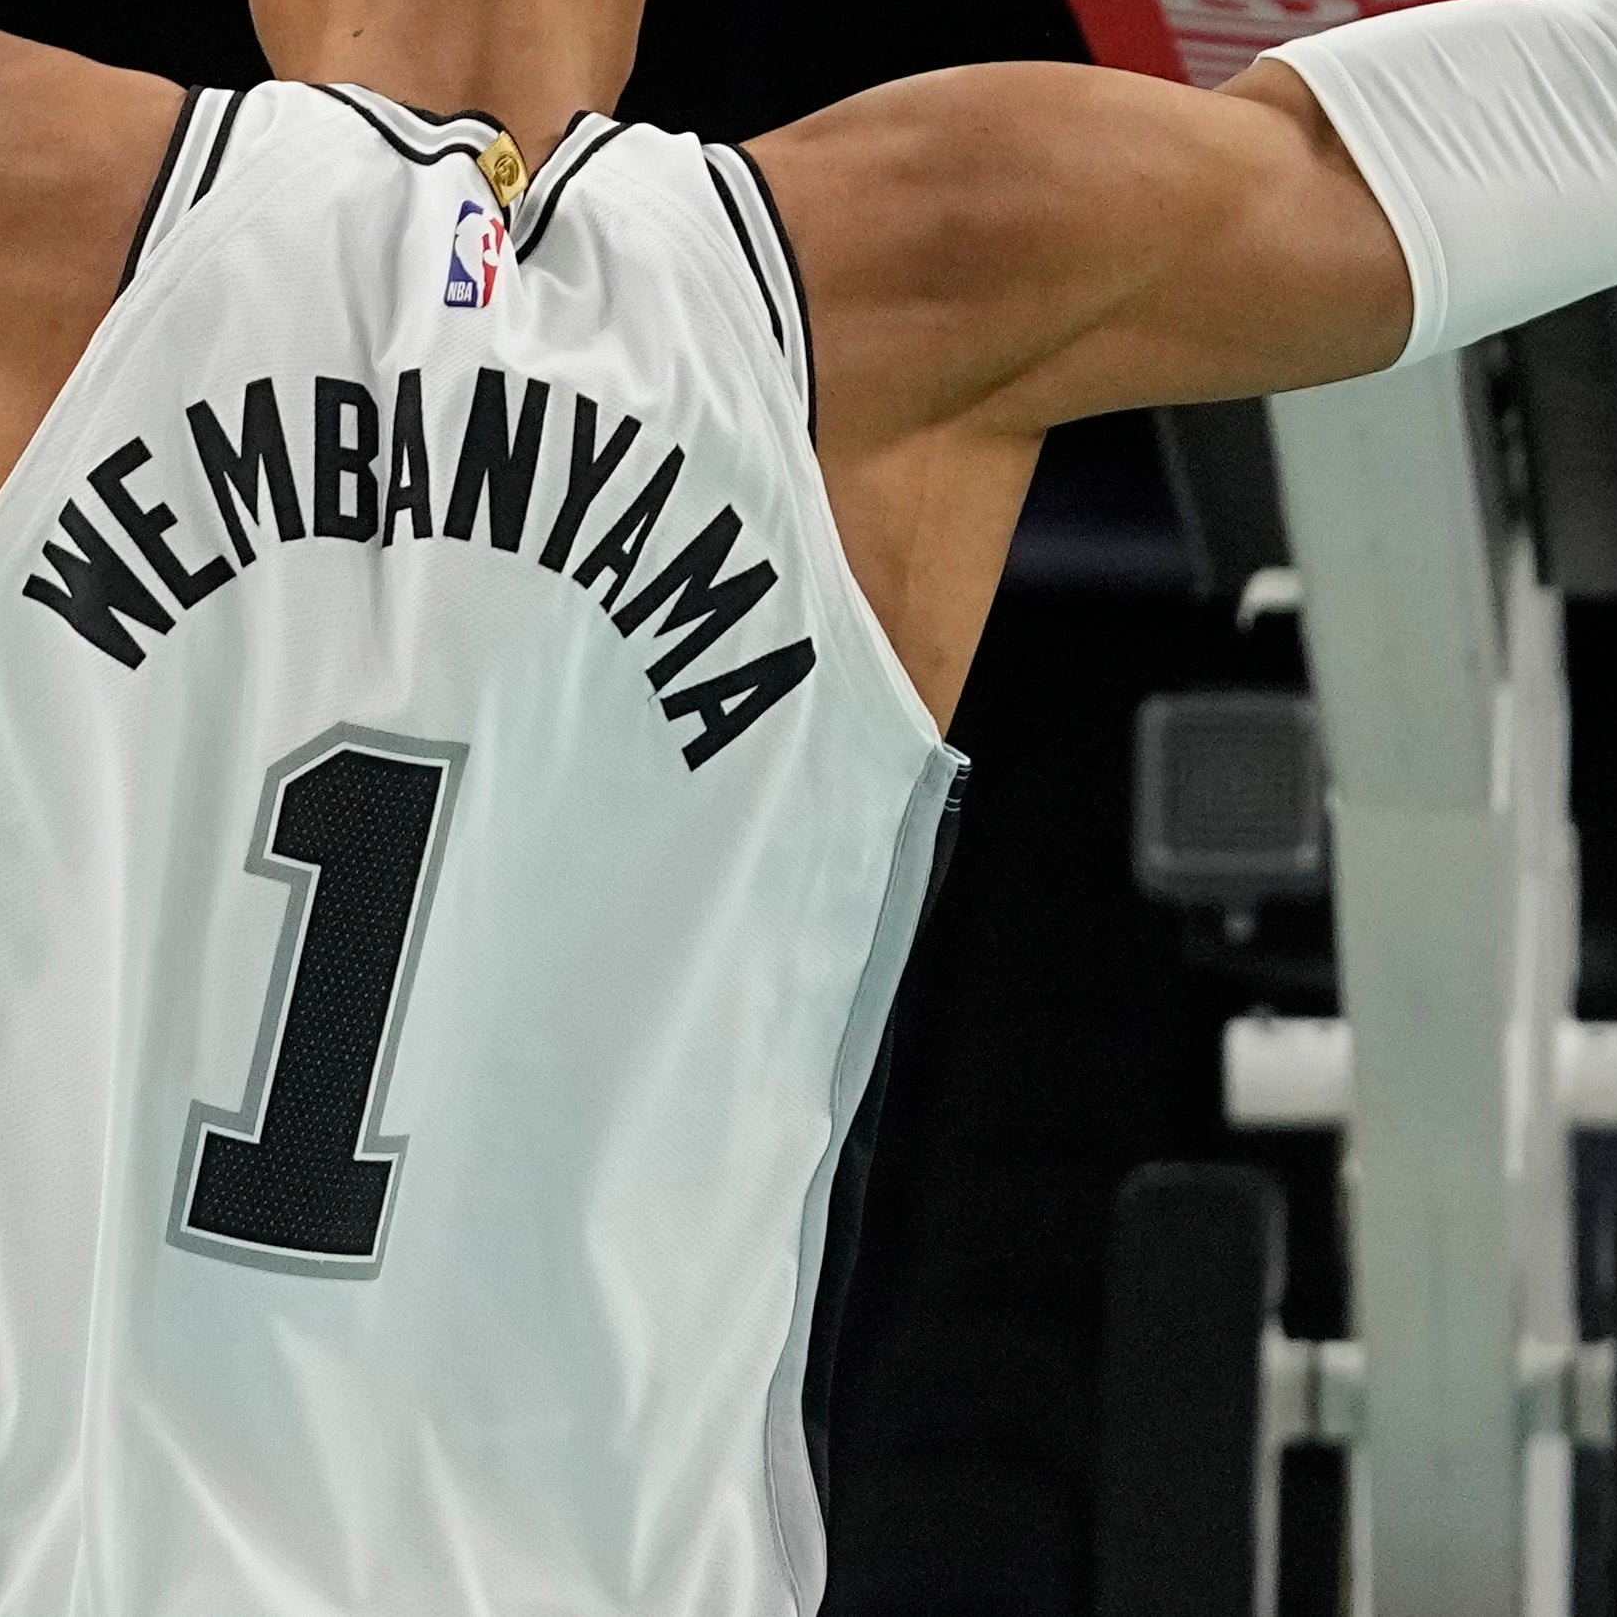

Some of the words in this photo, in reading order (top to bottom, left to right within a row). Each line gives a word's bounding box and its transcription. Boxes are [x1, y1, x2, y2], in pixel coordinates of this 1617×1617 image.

[447, 281, 473, 302] NBA
[22, 366, 818, 772] WEMBANYAMA
[166, 720, 471, 1281] 1
